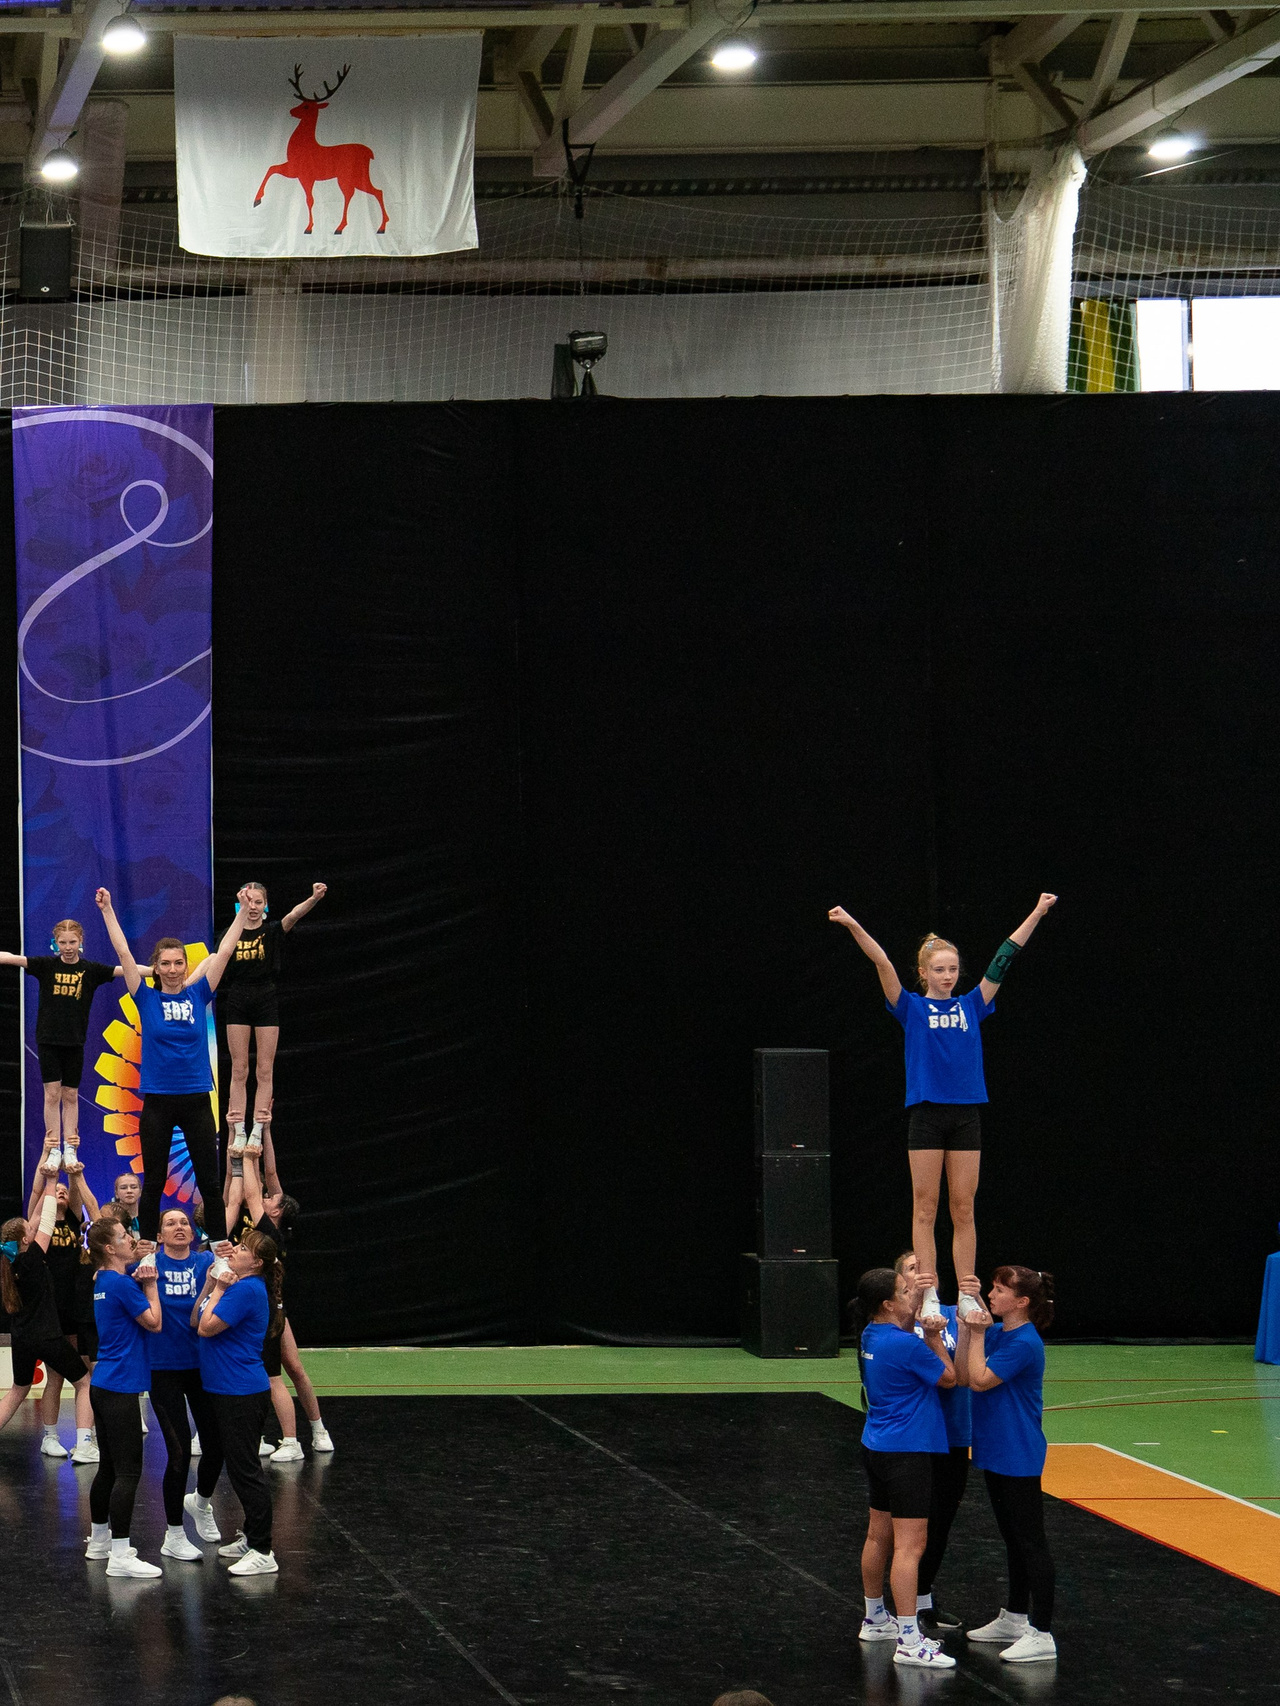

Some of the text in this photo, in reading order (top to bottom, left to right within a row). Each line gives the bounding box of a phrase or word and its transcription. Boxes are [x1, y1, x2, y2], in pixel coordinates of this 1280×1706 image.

[236, 950, 258, 961] БОР
[54, 972, 79, 984] ЧИР
[53, 985, 76, 996] БОР
[164, 1009, 190, 1021] БОР
[928, 1014, 960, 1029] БОР
[164, 1270, 190, 1283] ЧИР
[165, 1284, 190, 1295] БОР
